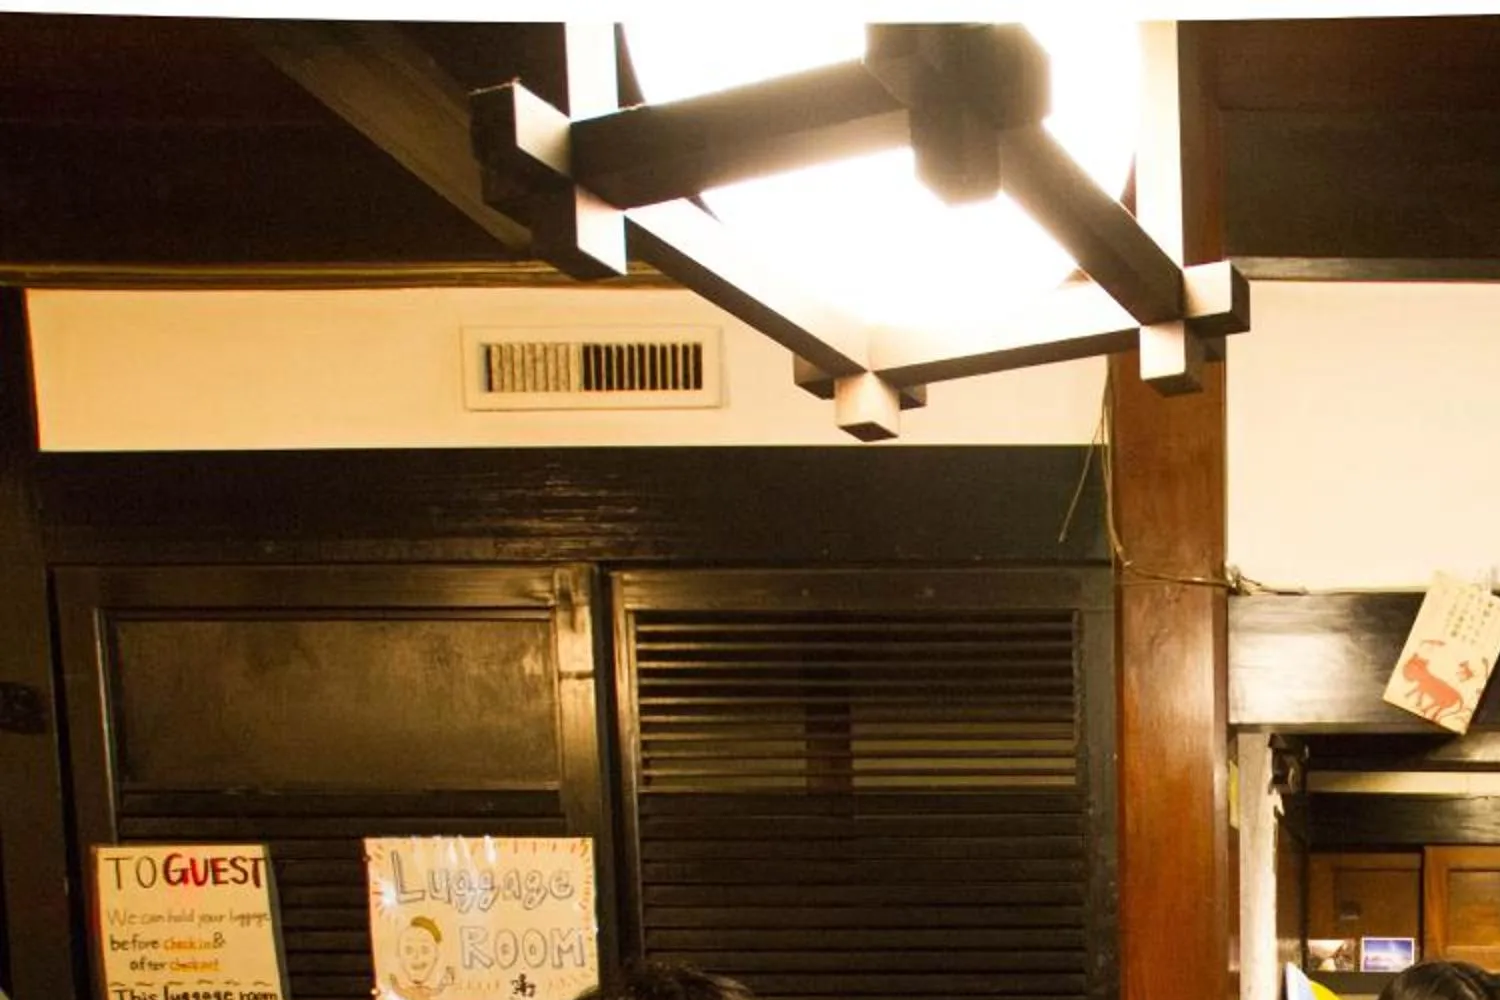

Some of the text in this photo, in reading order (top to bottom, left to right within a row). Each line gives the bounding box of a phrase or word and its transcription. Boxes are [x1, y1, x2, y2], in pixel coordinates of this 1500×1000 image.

[103, 853, 267, 890] TO GUEST
[391, 850, 574, 913] Luggage
[110, 932, 160, 951] before
[459, 926, 586, 969] ROOM
[129, 957, 167, 971] after
